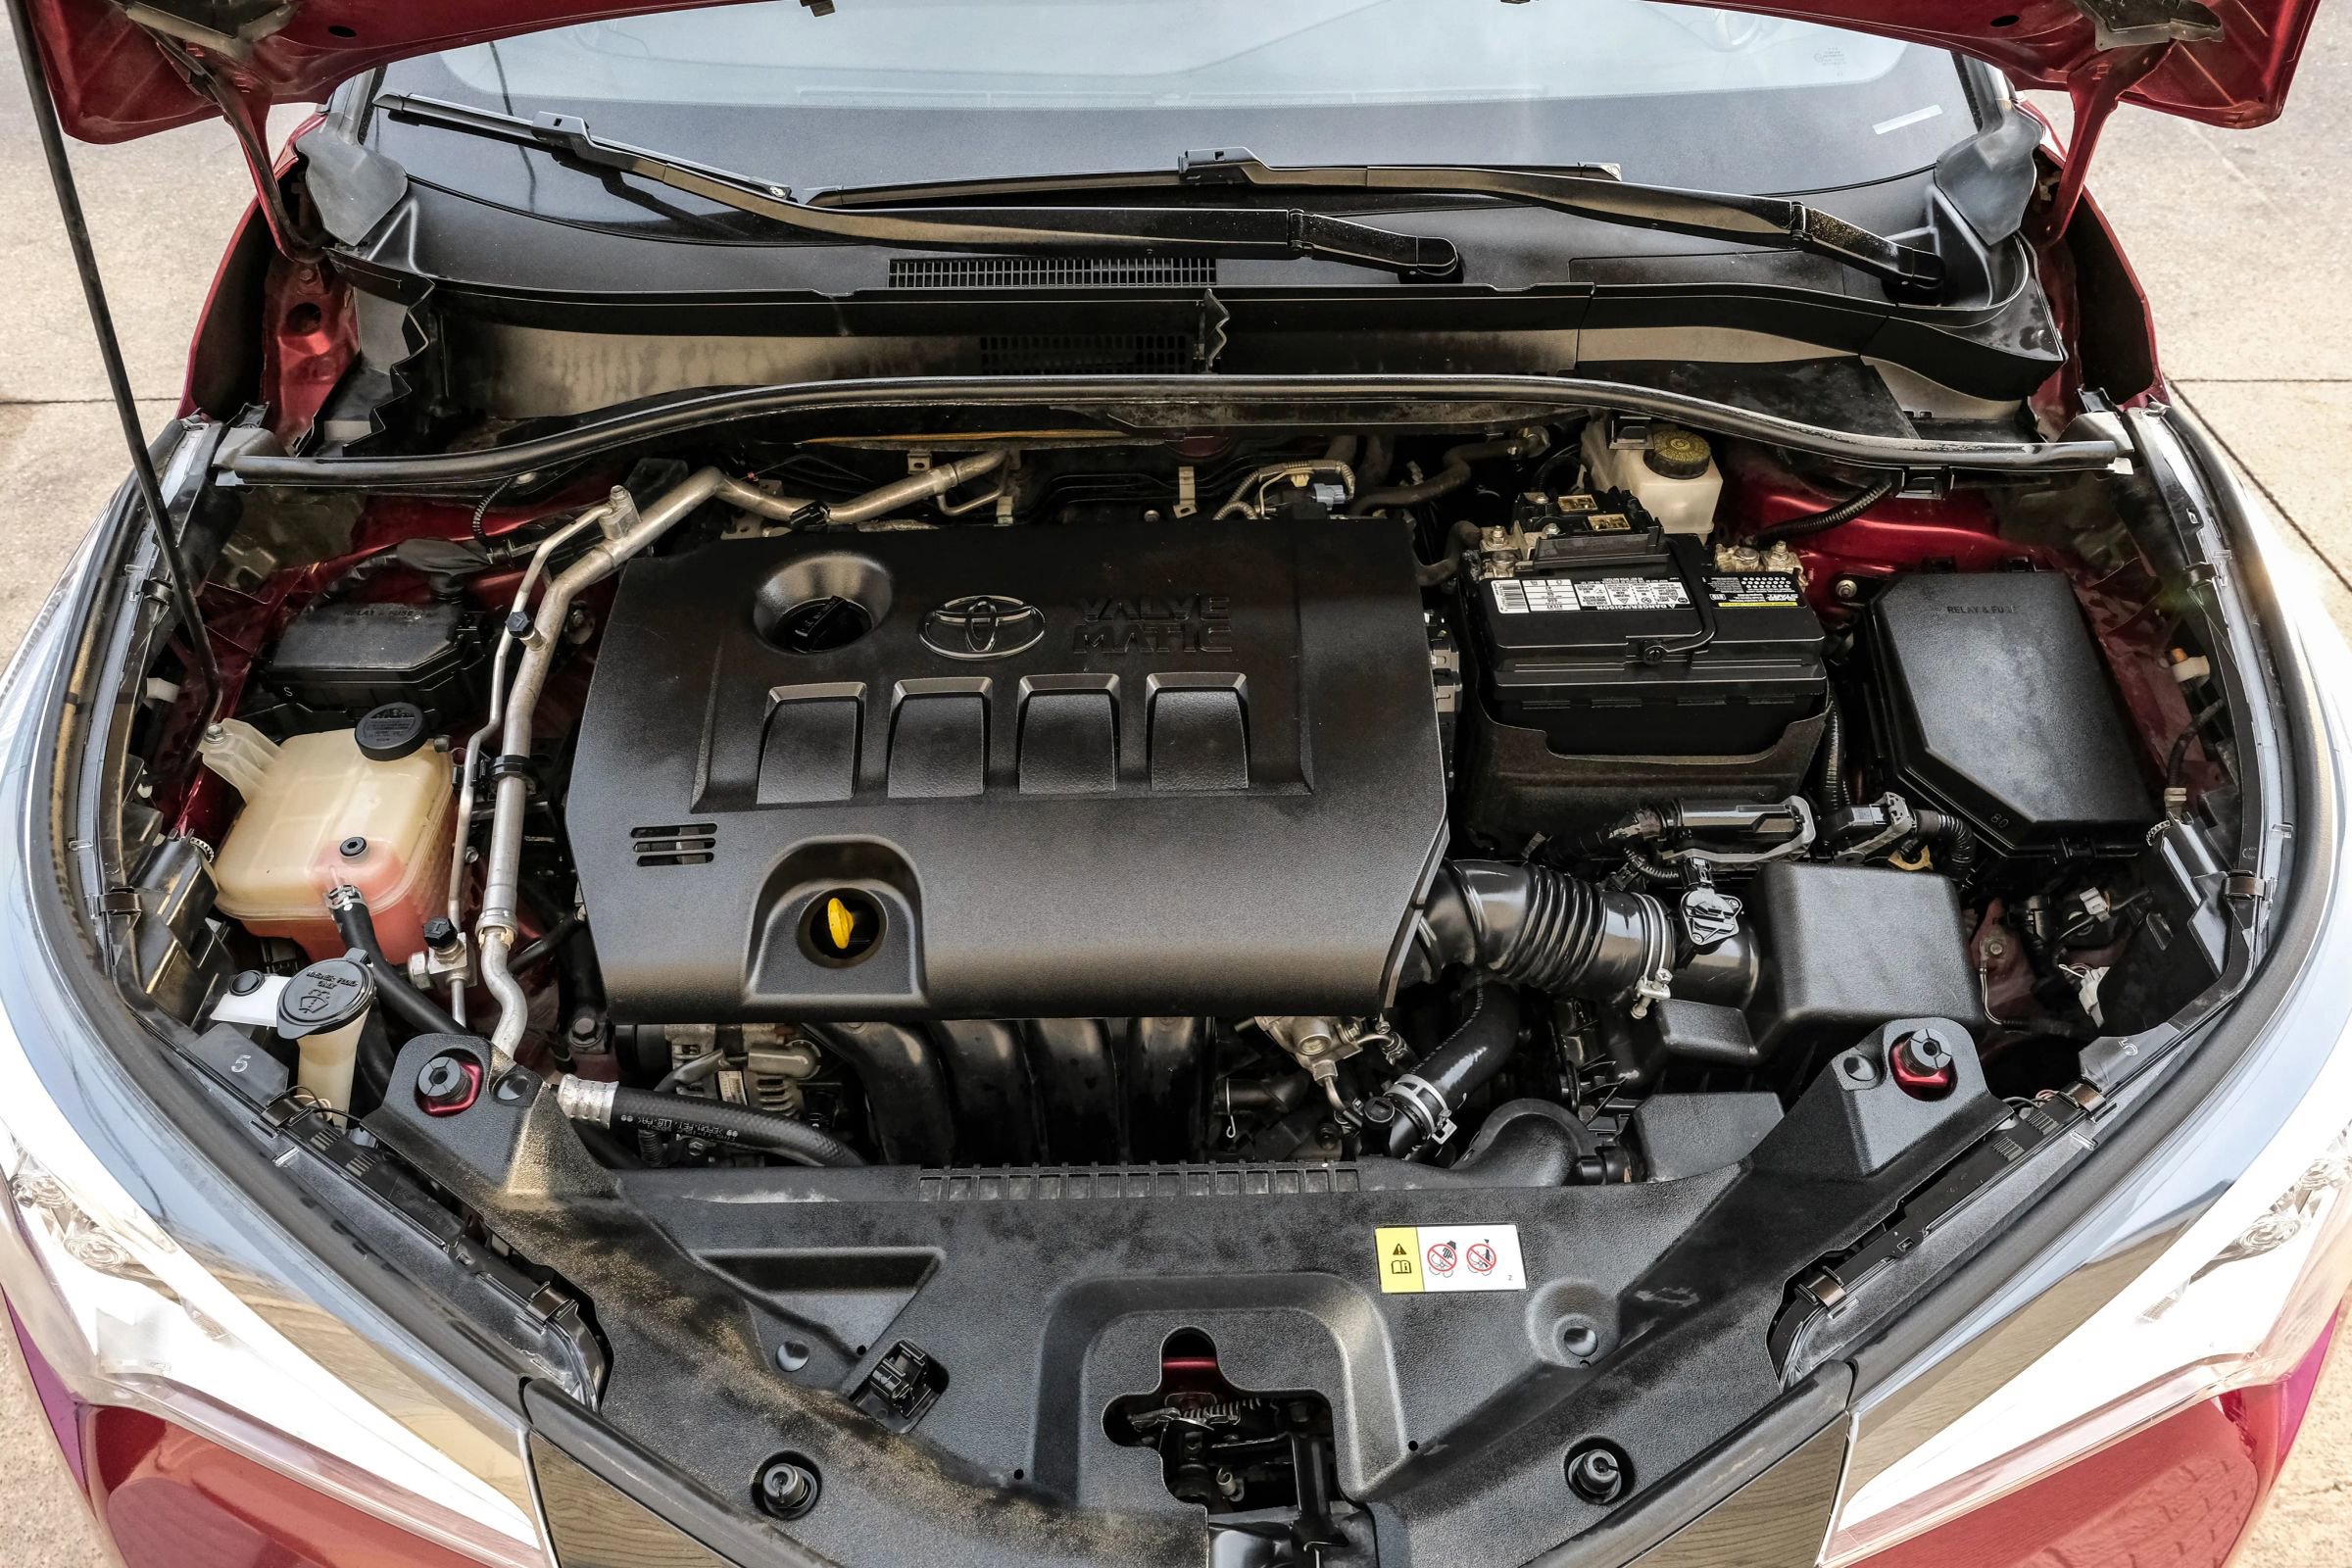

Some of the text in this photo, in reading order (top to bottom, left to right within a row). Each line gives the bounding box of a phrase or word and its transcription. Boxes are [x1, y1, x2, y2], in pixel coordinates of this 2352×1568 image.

[1074, 596, 1231, 622] VALVE
[1073, 623, 1233, 655] MATIC
[306, 971, 359, 987] WASHER FLUID
[318, 981, 337, 990] ONLY
[231, 1054, 252, 1072] 5
